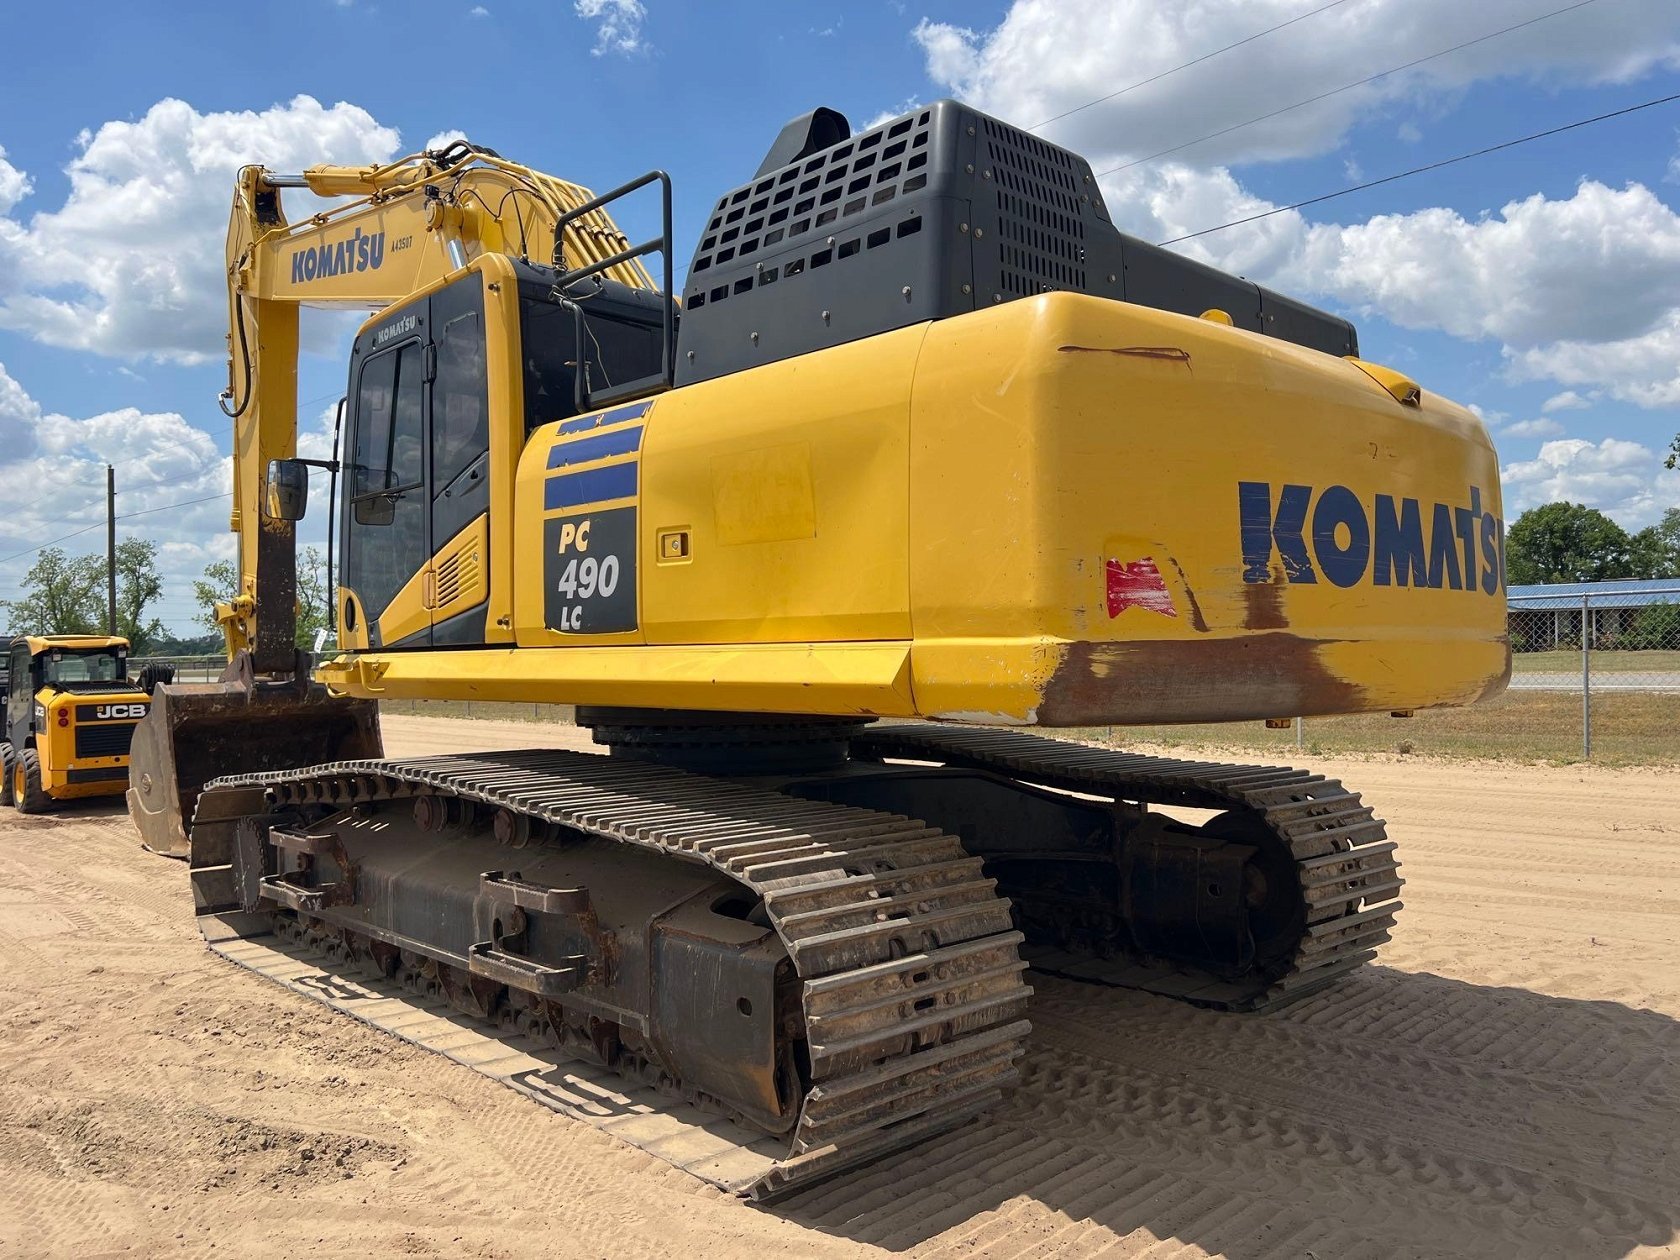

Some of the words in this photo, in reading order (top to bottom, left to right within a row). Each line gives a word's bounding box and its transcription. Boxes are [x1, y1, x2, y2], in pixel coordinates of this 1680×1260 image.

[291, 227, 385, 284] KOMATSU
[378, 315, 416, 344] KOMATSU
[558, 520, 591, 554] PC
[558, 555, 620, 599] 490
[560, 605, 583, 631] LC
[97, 704, 146, 718] JCB
